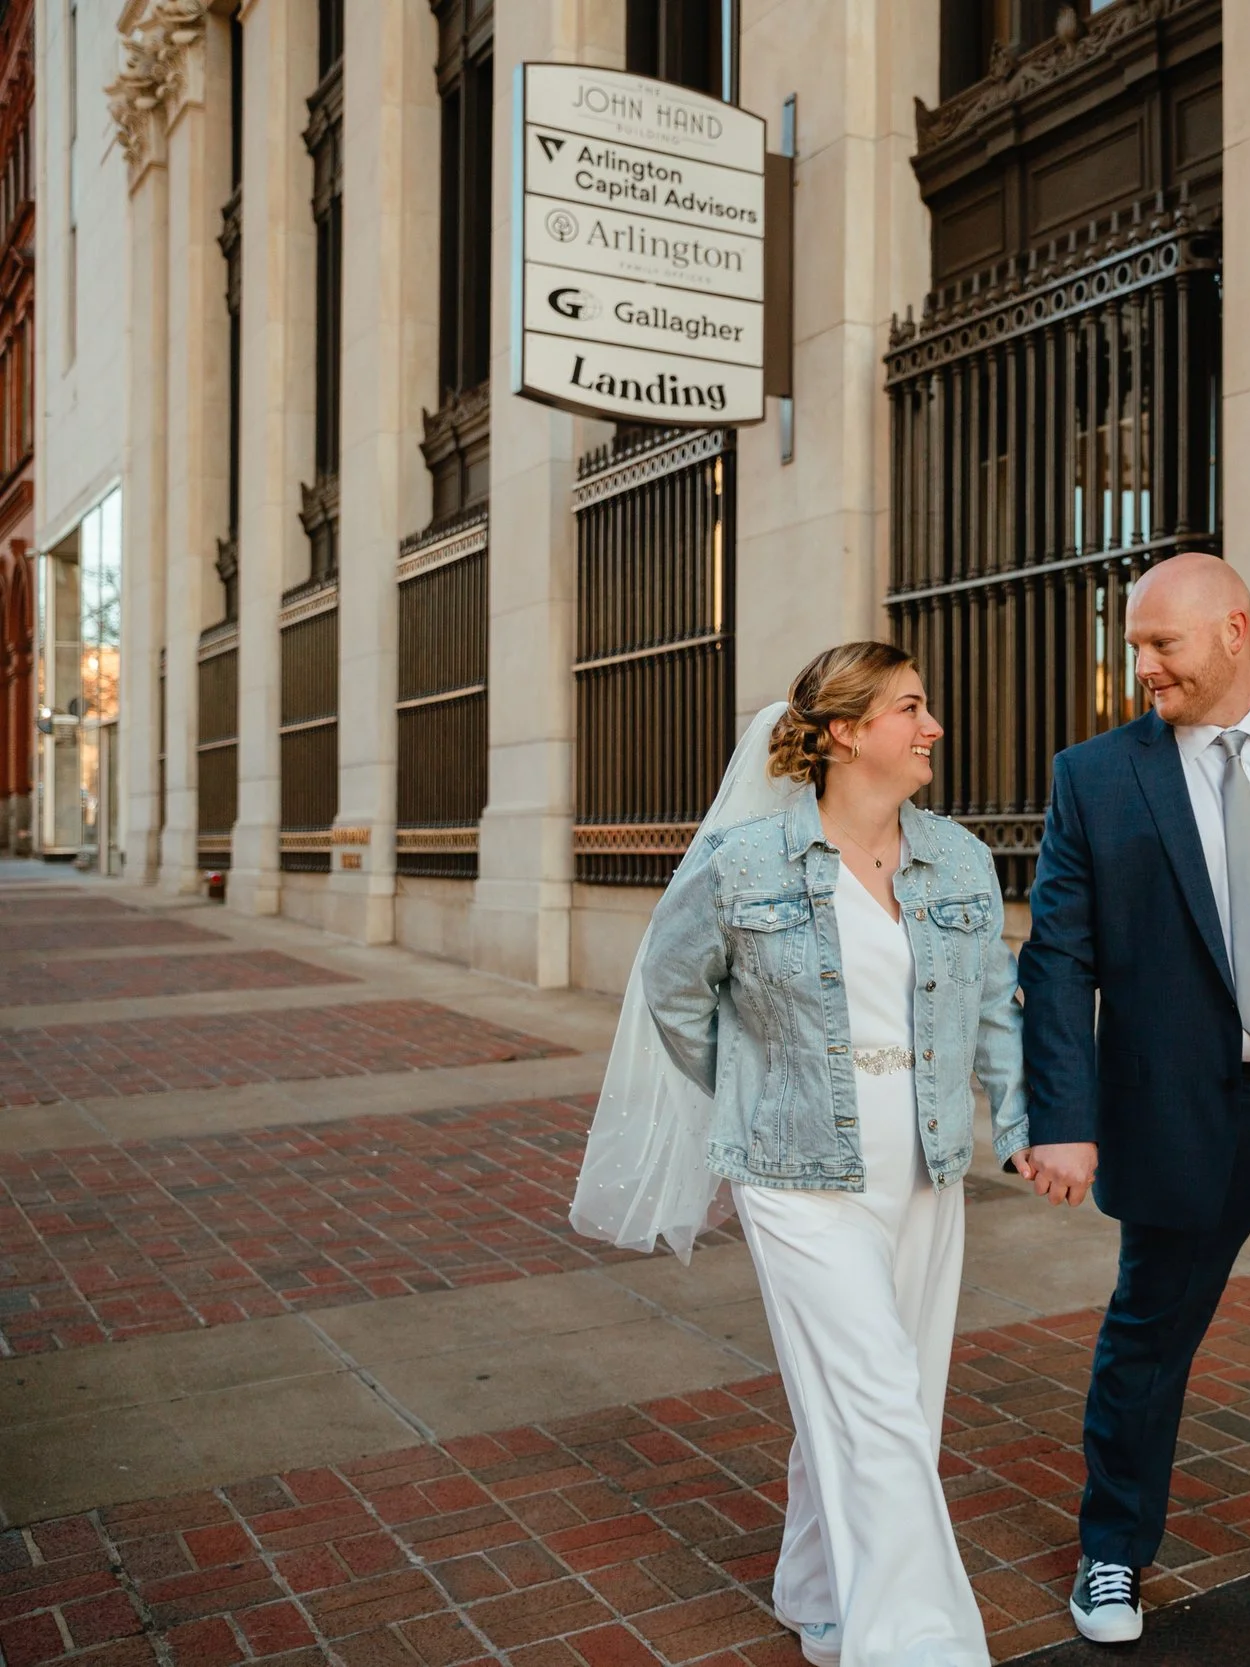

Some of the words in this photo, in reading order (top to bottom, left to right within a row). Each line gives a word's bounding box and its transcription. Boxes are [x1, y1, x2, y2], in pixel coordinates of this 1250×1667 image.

[572, 85, 643, 121] JOHN
[657, 104, 723, 140] HAND
[616, 123, 680, 145] BUILDING
[577, 146, 682, 185] Arlington
[575, 170, 656, 204] Capital
[664, 189, 758, 224] Advisors
[587, 220, 743, 271] Arlington
[614, 302, 743, 342] Gallagher
[569, 355, 727, 410] Landing
